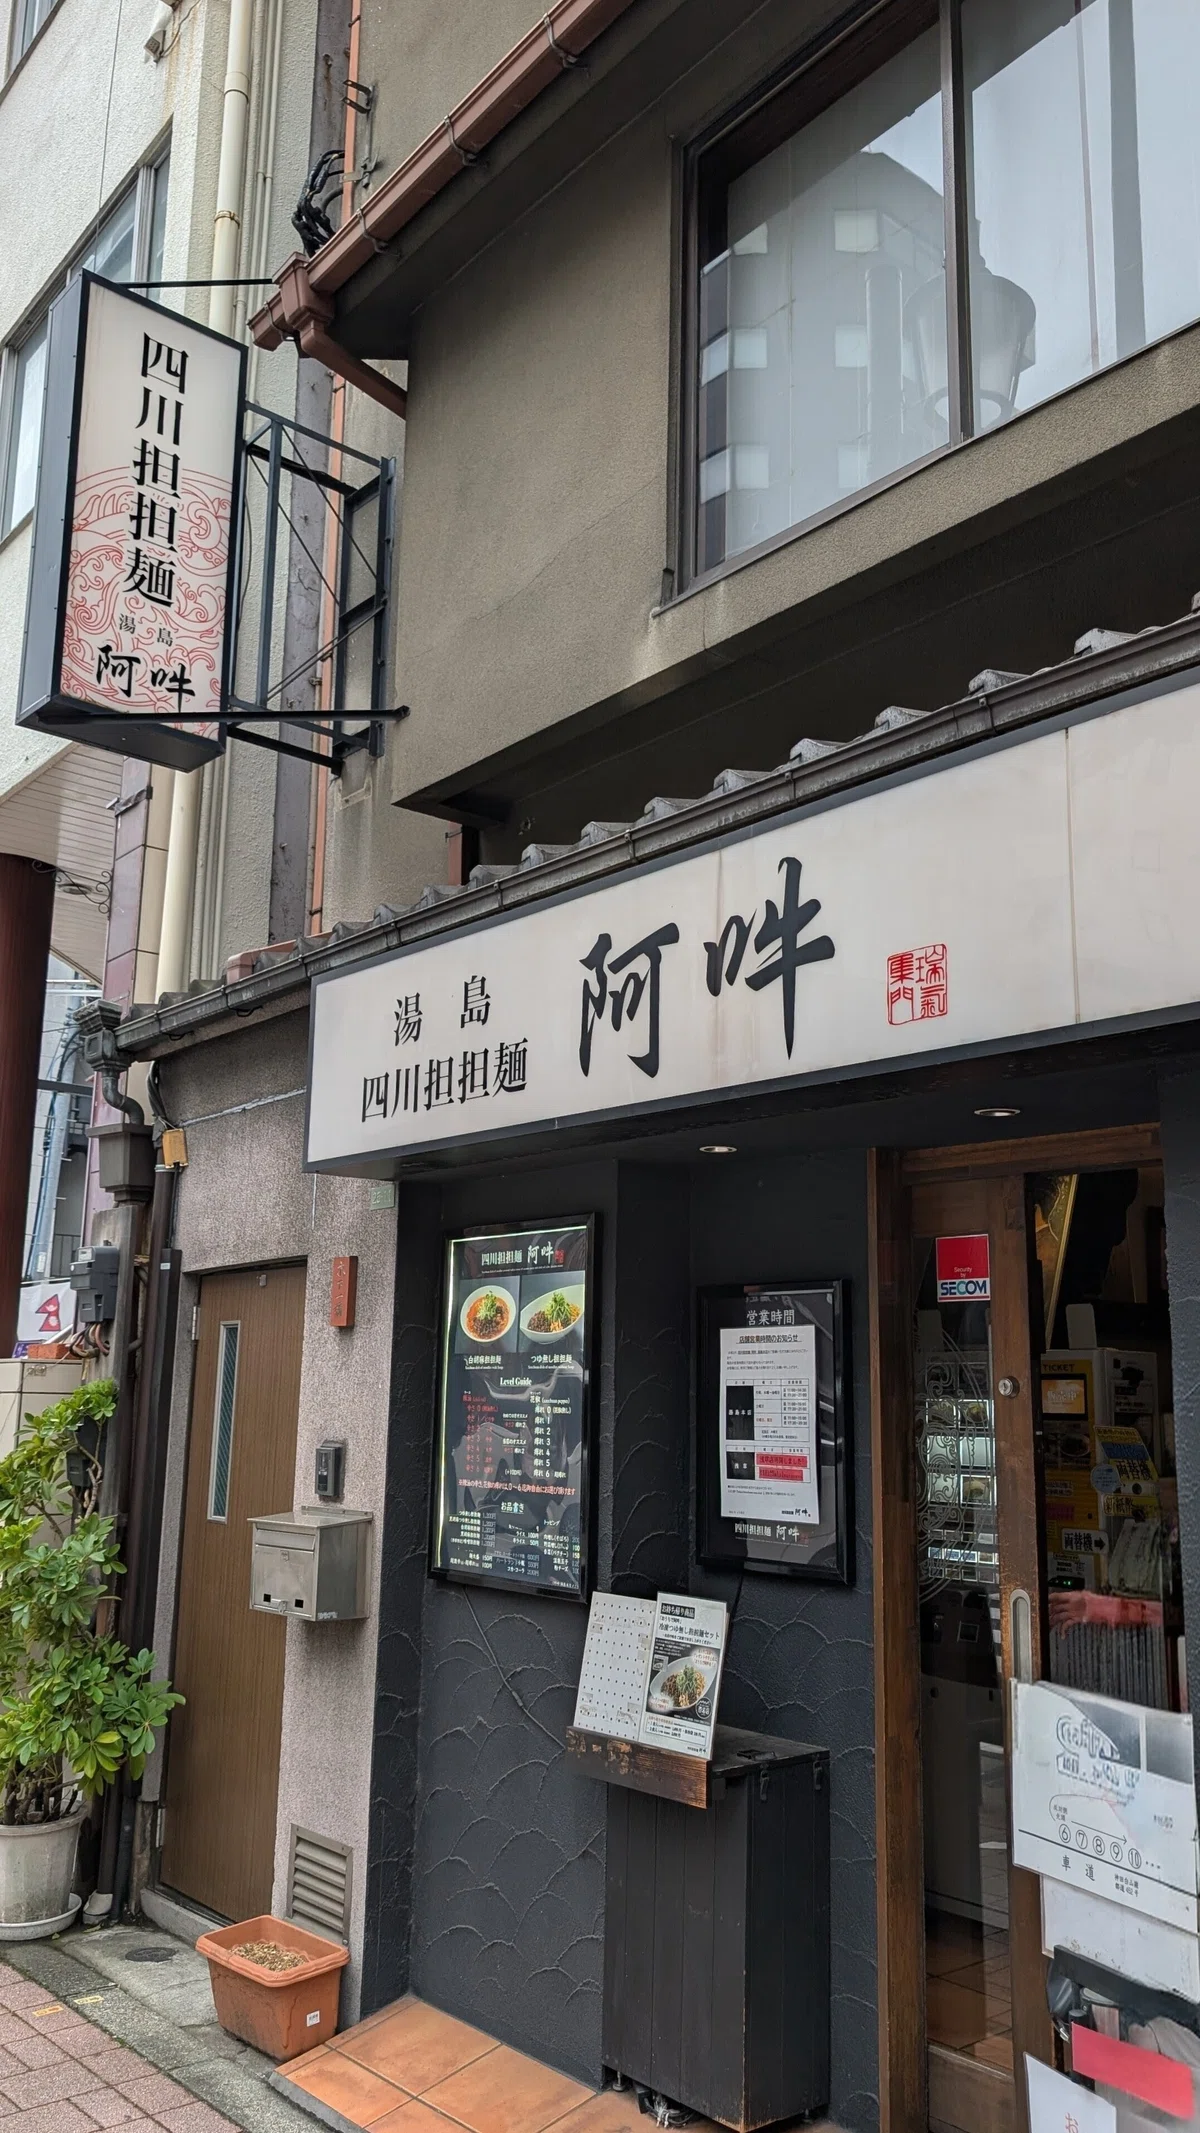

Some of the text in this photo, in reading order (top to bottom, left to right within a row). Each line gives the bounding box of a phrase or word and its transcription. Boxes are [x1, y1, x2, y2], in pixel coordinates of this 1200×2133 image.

[122, 332, 189, 608] 四川担担麺
[119, 613, 173, 646] 湯島
[96, 645, 196, 713] 阿吽
[579, 857, 834, 1077] 阿吽
[393, 975, 491, 1047] 湯島
[361, 1038, 528, 1122] 四川担担麺
[481, 1250, 522, 1266] 四川担担麺
[527, 1241, 554, 1264] 阿吽
[941, 1280, 986, 1295] SECOM
[747, 1309, 795, 1326] 営業時間
[739, 1334, 798, 1343] 店舗営業時間のお知らせ
[500, 1377, 532, 1386] Level Guide
[1116, 1460, 1152, 1481] 両替機
[501, 1502, 524, 1512] お品書き
[735, 1523, 771, 1537] 四川担担麺
[776, 1524, 800, 1542] 阿吽
[1064, 1532, 1093, 1551] 両替機
[662, 1605, 694, 1617] お持ち帰り商品
